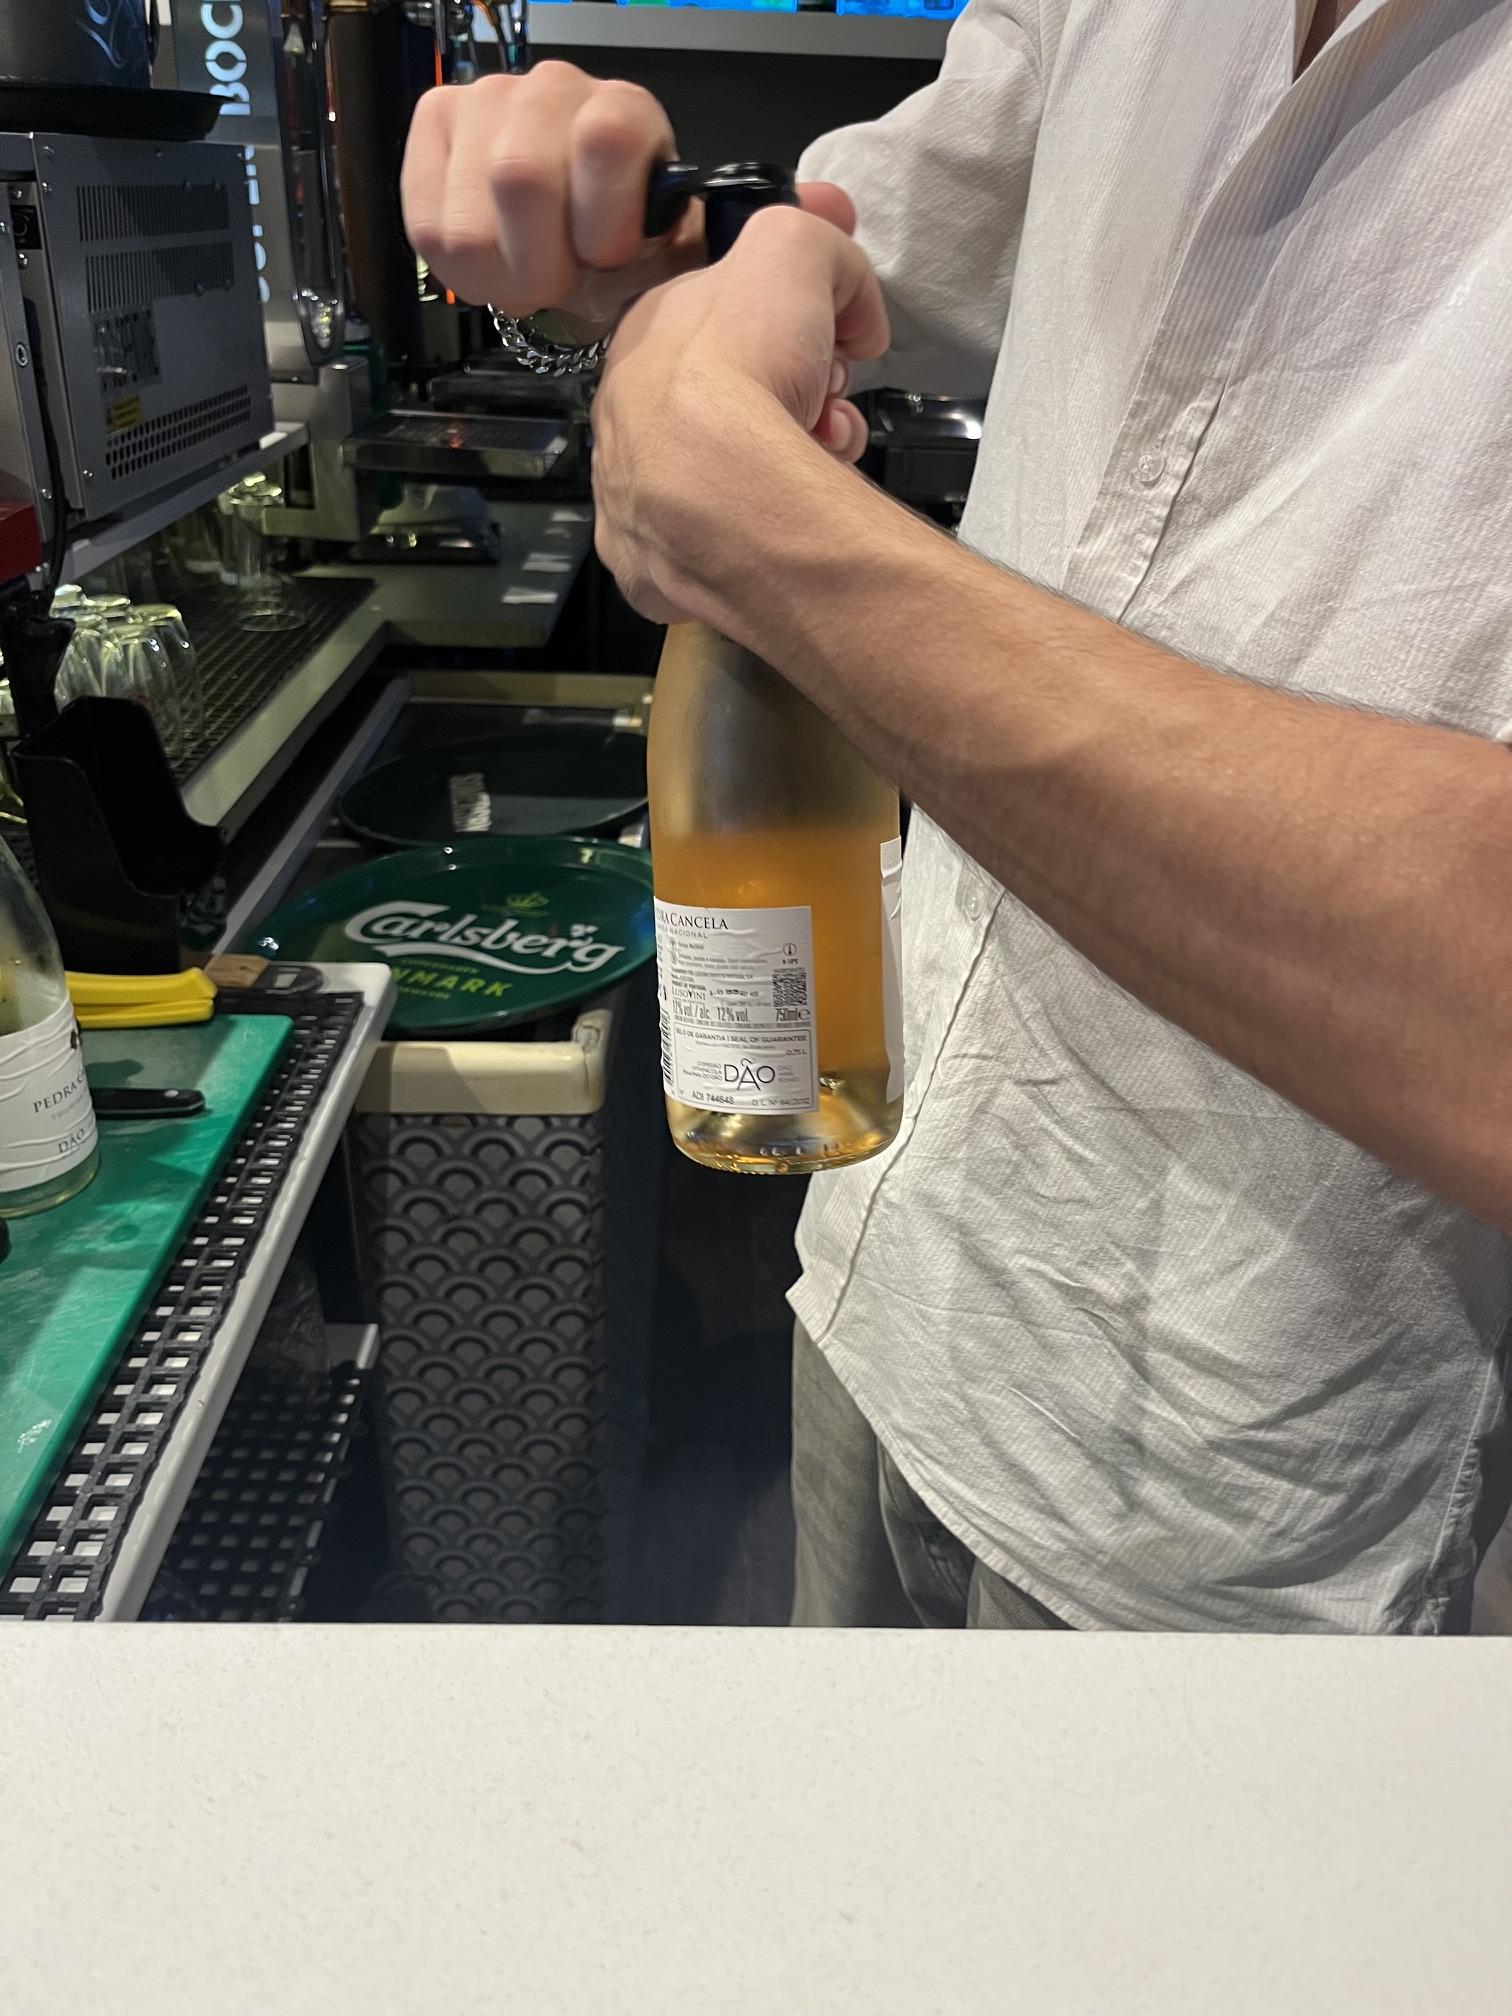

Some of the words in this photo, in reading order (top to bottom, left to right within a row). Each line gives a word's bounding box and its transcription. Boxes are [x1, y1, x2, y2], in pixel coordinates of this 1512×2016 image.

[200, 0, 251, 116] BOC
[345, 900, 626, 973] Carlsberg
[670, 912, 729, 930] CANCELA
[394, 966, 513, 997] NMARK
[716, 1006, 735, 1022] 12%
[695, 1031, 726, 1042] GARANTIA
[730, 1034, 748, 1043] SEAL
[749, 1035, 760, 1044] OF
[761, 1034, 807, 1044] GUARANTEE
[724, 1056, 776, 1091] DÃO
[33, 1081, 78, 1114] PEDRA
